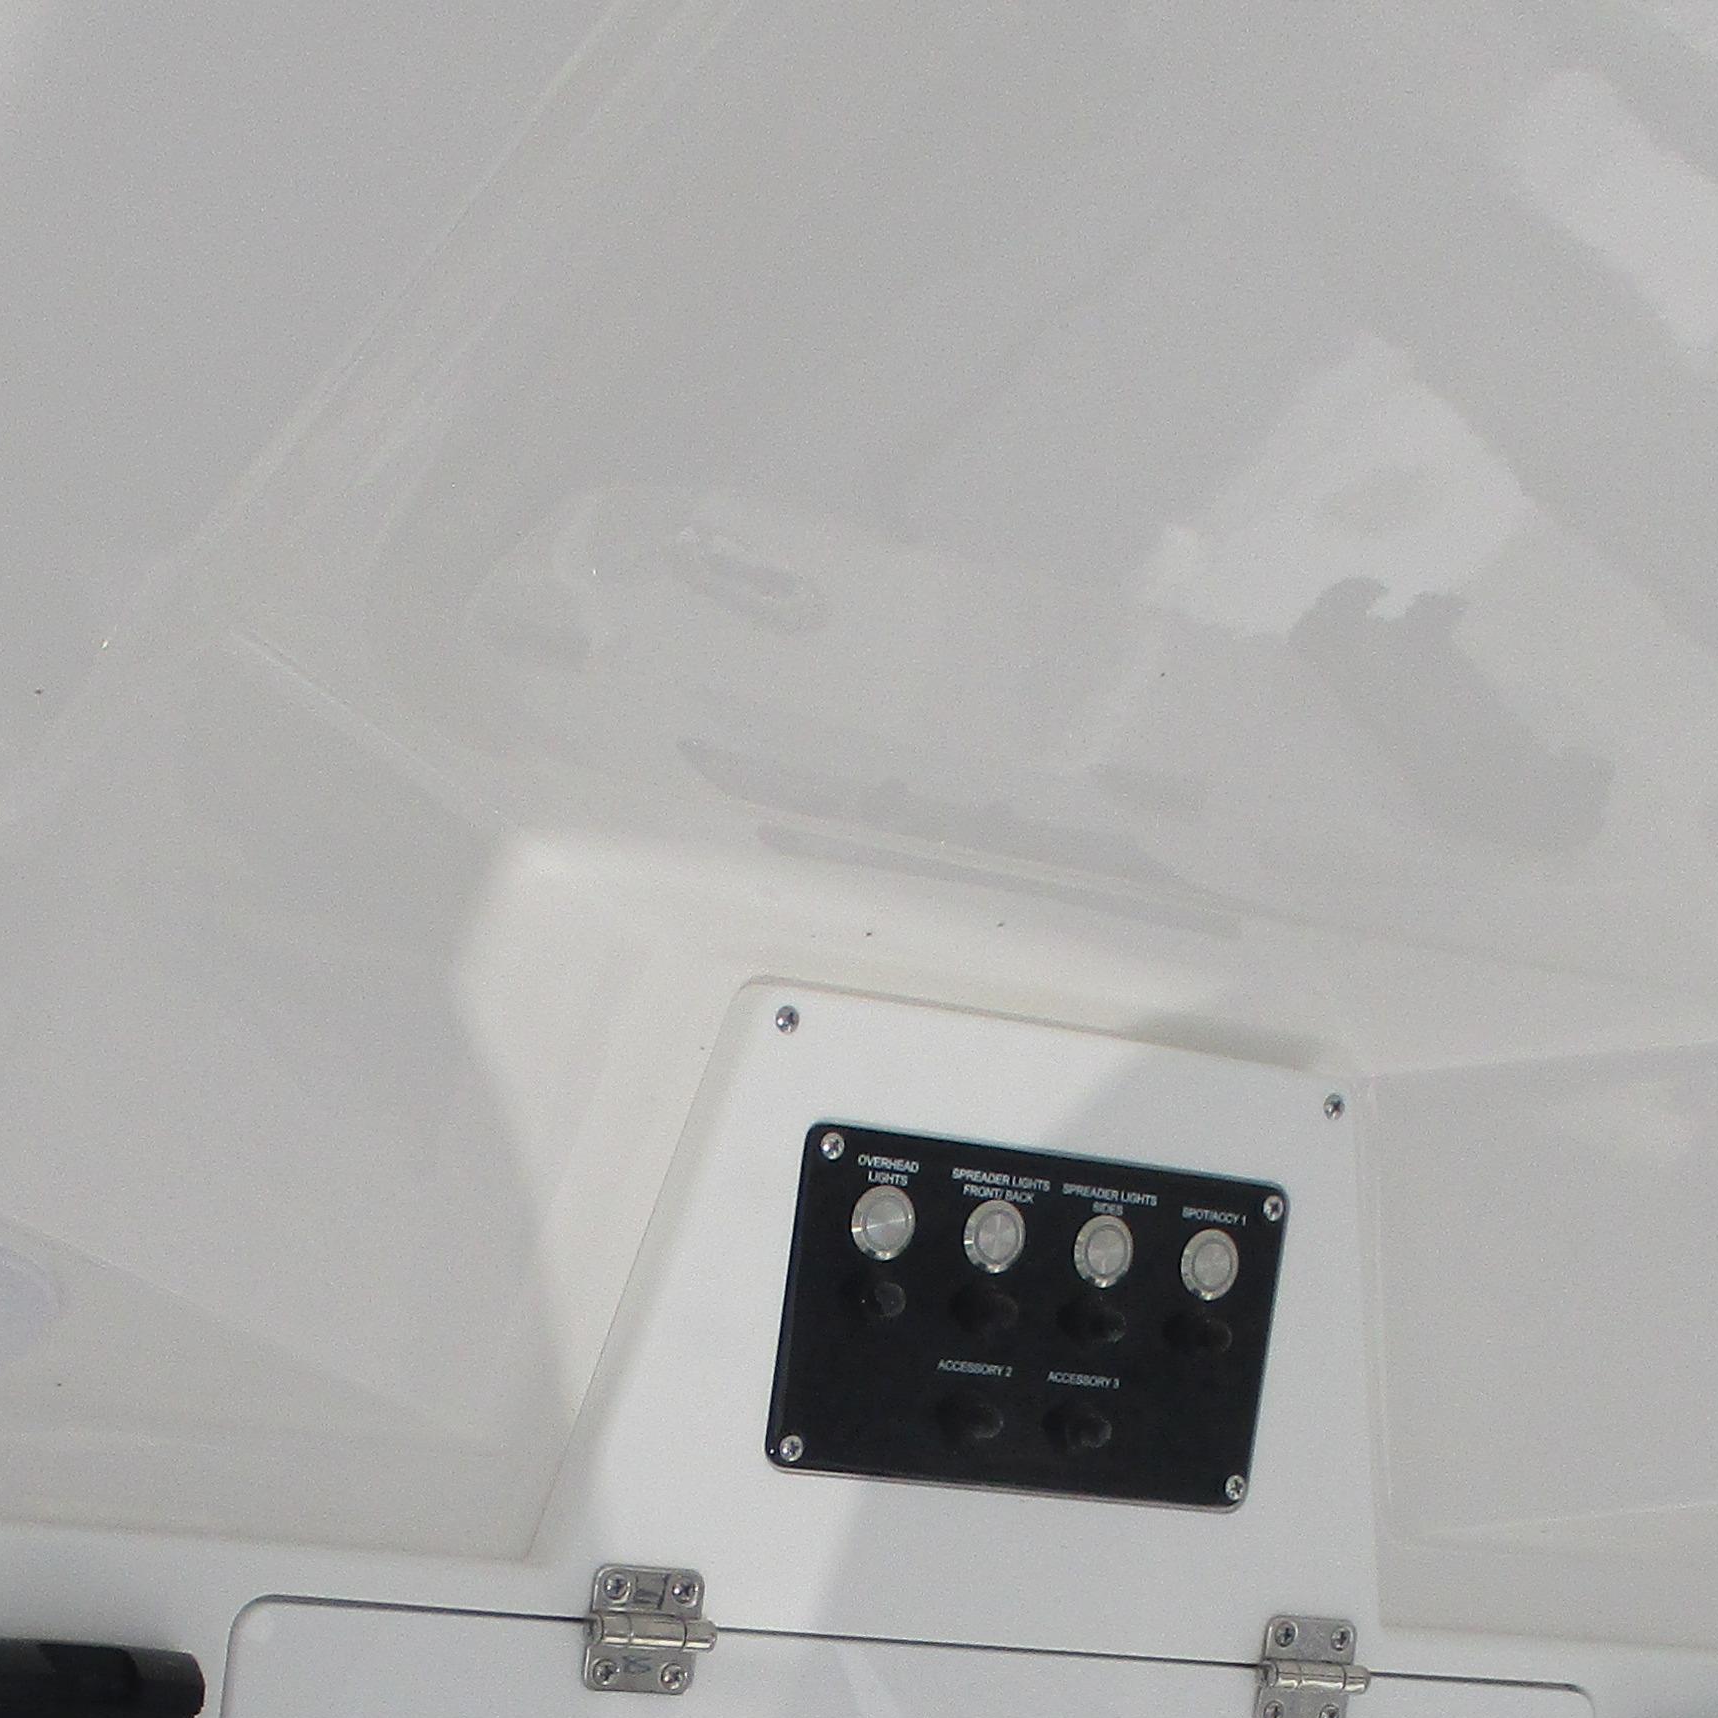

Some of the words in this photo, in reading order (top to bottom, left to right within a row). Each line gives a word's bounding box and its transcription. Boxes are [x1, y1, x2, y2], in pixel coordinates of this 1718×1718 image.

[858, 1154, 919, 1173] OVERHEAD
[868, 1171, 908, 1187] LIGHTS
[952, 1167, 1010, 1187] SPREADER
[1012, 1175, 1050, 1192] LIGHTS
[1004, 1189, 1035, 1204] BACK
[1062, 1183, 1120, 1202] SPREADER
[1121, 1190, 1157, 1206] LIGHTS
[1092, 1202, 1123, 1216] SIDES
[937, 1359, 1004, 1376] ACCESSORY
[1005, 1366, 1013, 1378] 2
[1047, 1371, 1111, 1388] ACCESSORY
[1112, 1377, 1120, 1389] 3
